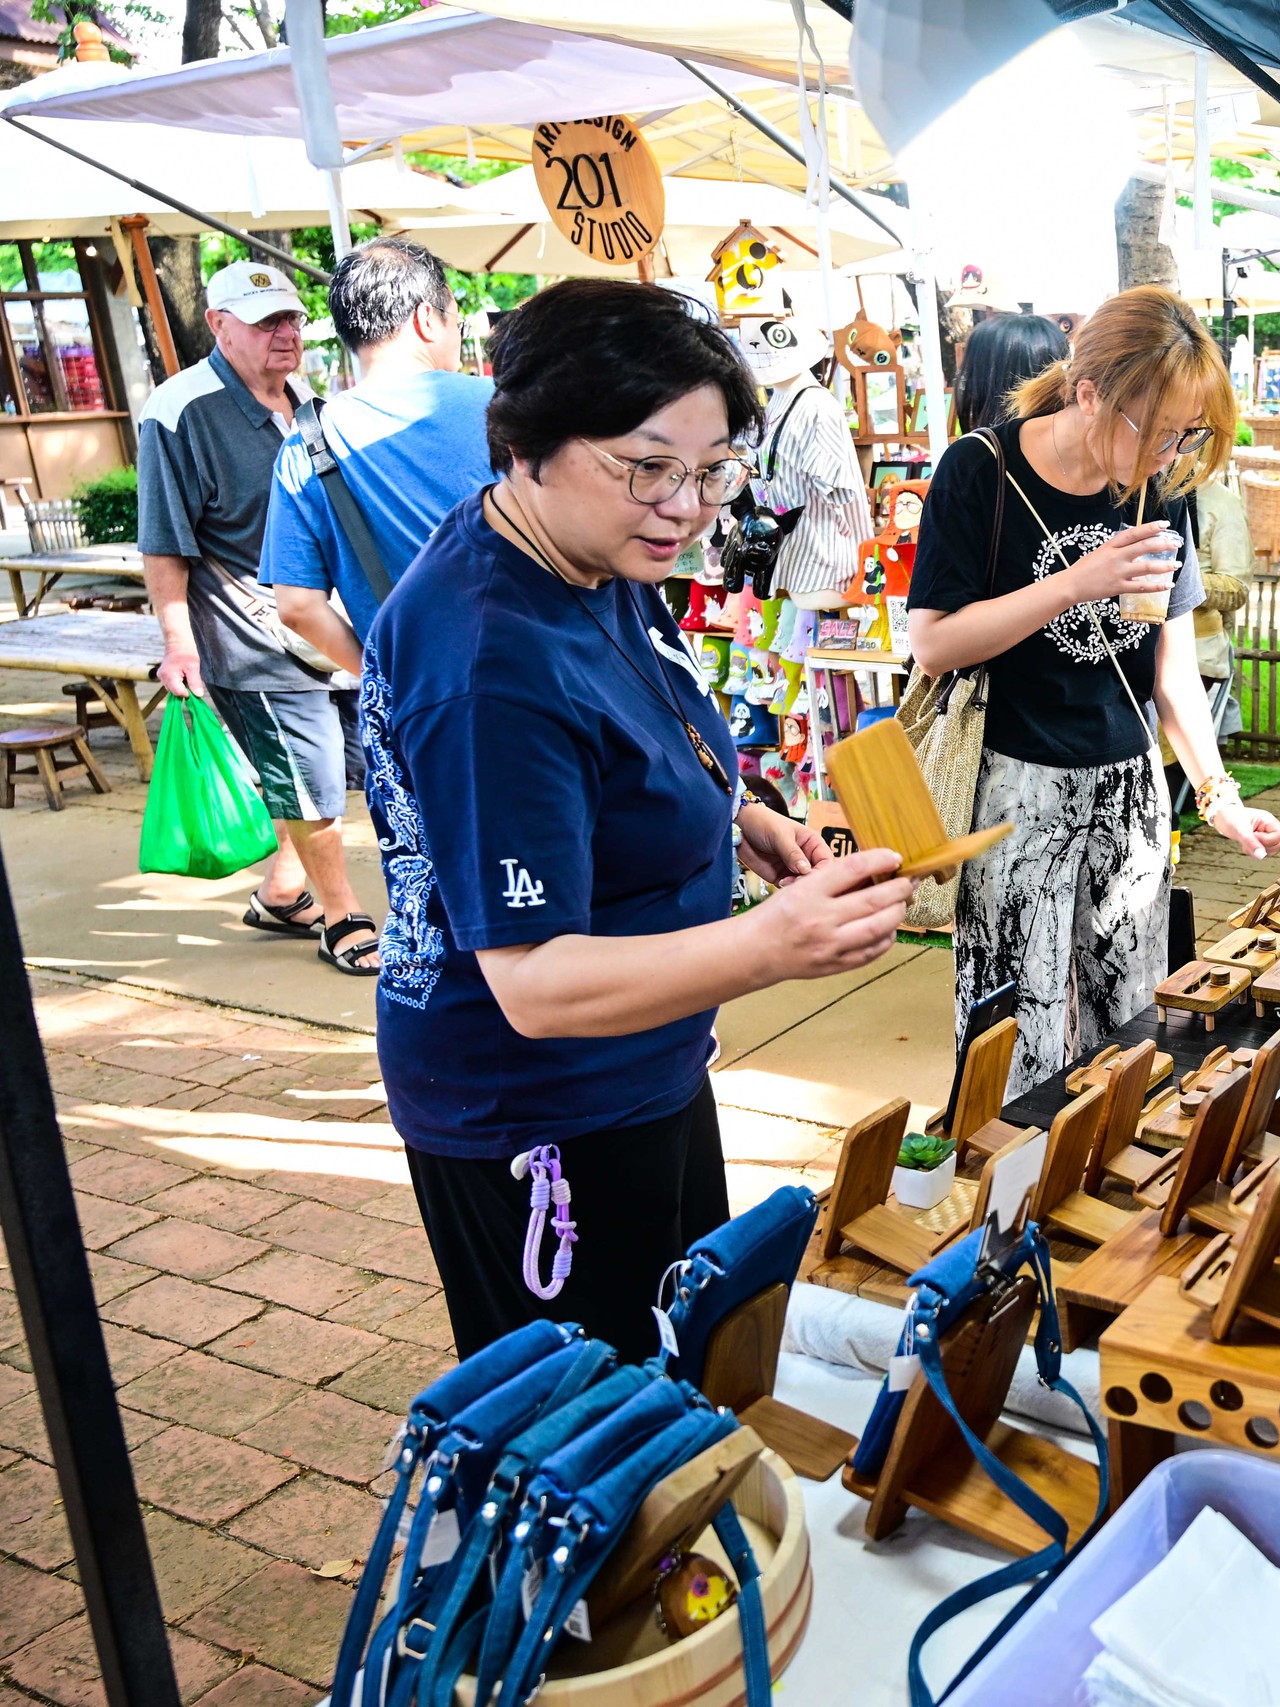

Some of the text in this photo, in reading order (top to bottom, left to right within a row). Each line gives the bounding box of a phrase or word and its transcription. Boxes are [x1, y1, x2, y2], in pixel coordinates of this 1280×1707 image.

[545, 152, 622, 210] 201
[571, 211, 652, 260] STUDIO
[820, 621, 857, 637] SALE
[500, 859, 546, 907] LA
